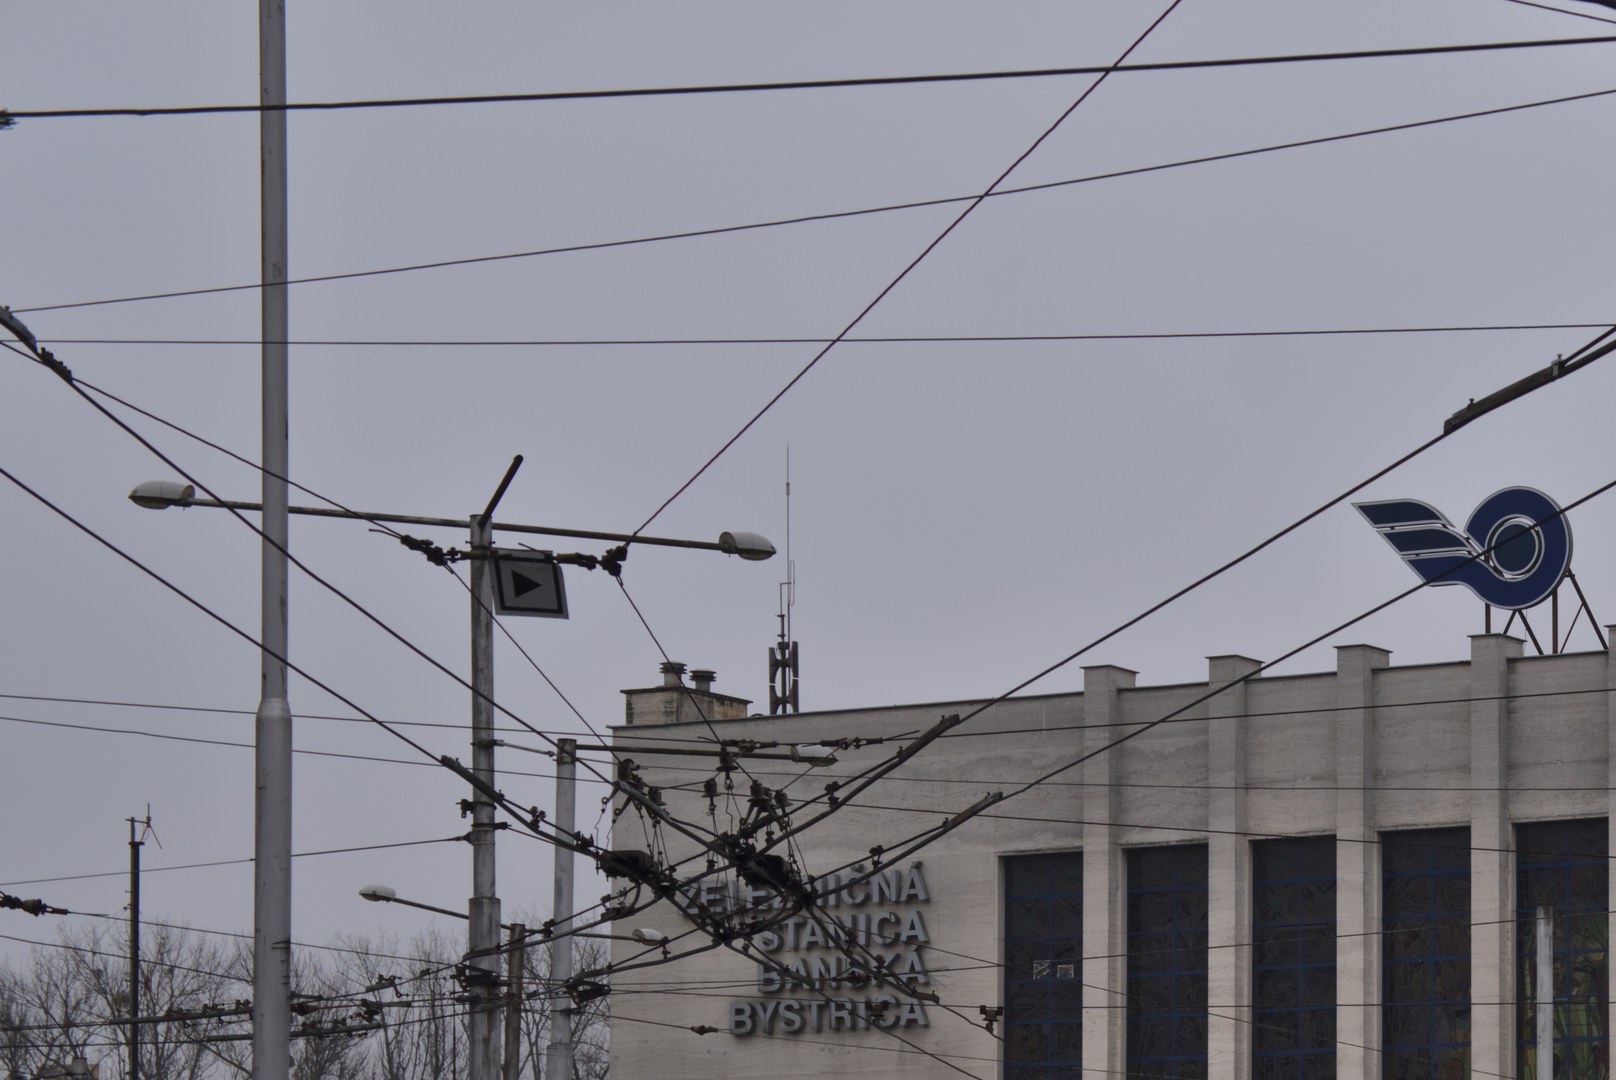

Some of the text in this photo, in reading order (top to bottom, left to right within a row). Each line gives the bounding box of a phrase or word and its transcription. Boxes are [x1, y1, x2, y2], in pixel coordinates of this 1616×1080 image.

[678, 861, 929, 915] ŽELEIČNÁ
[760, 910, 929, 952] STANICA
[729, 994, 929, 1036] BYSTRICA
